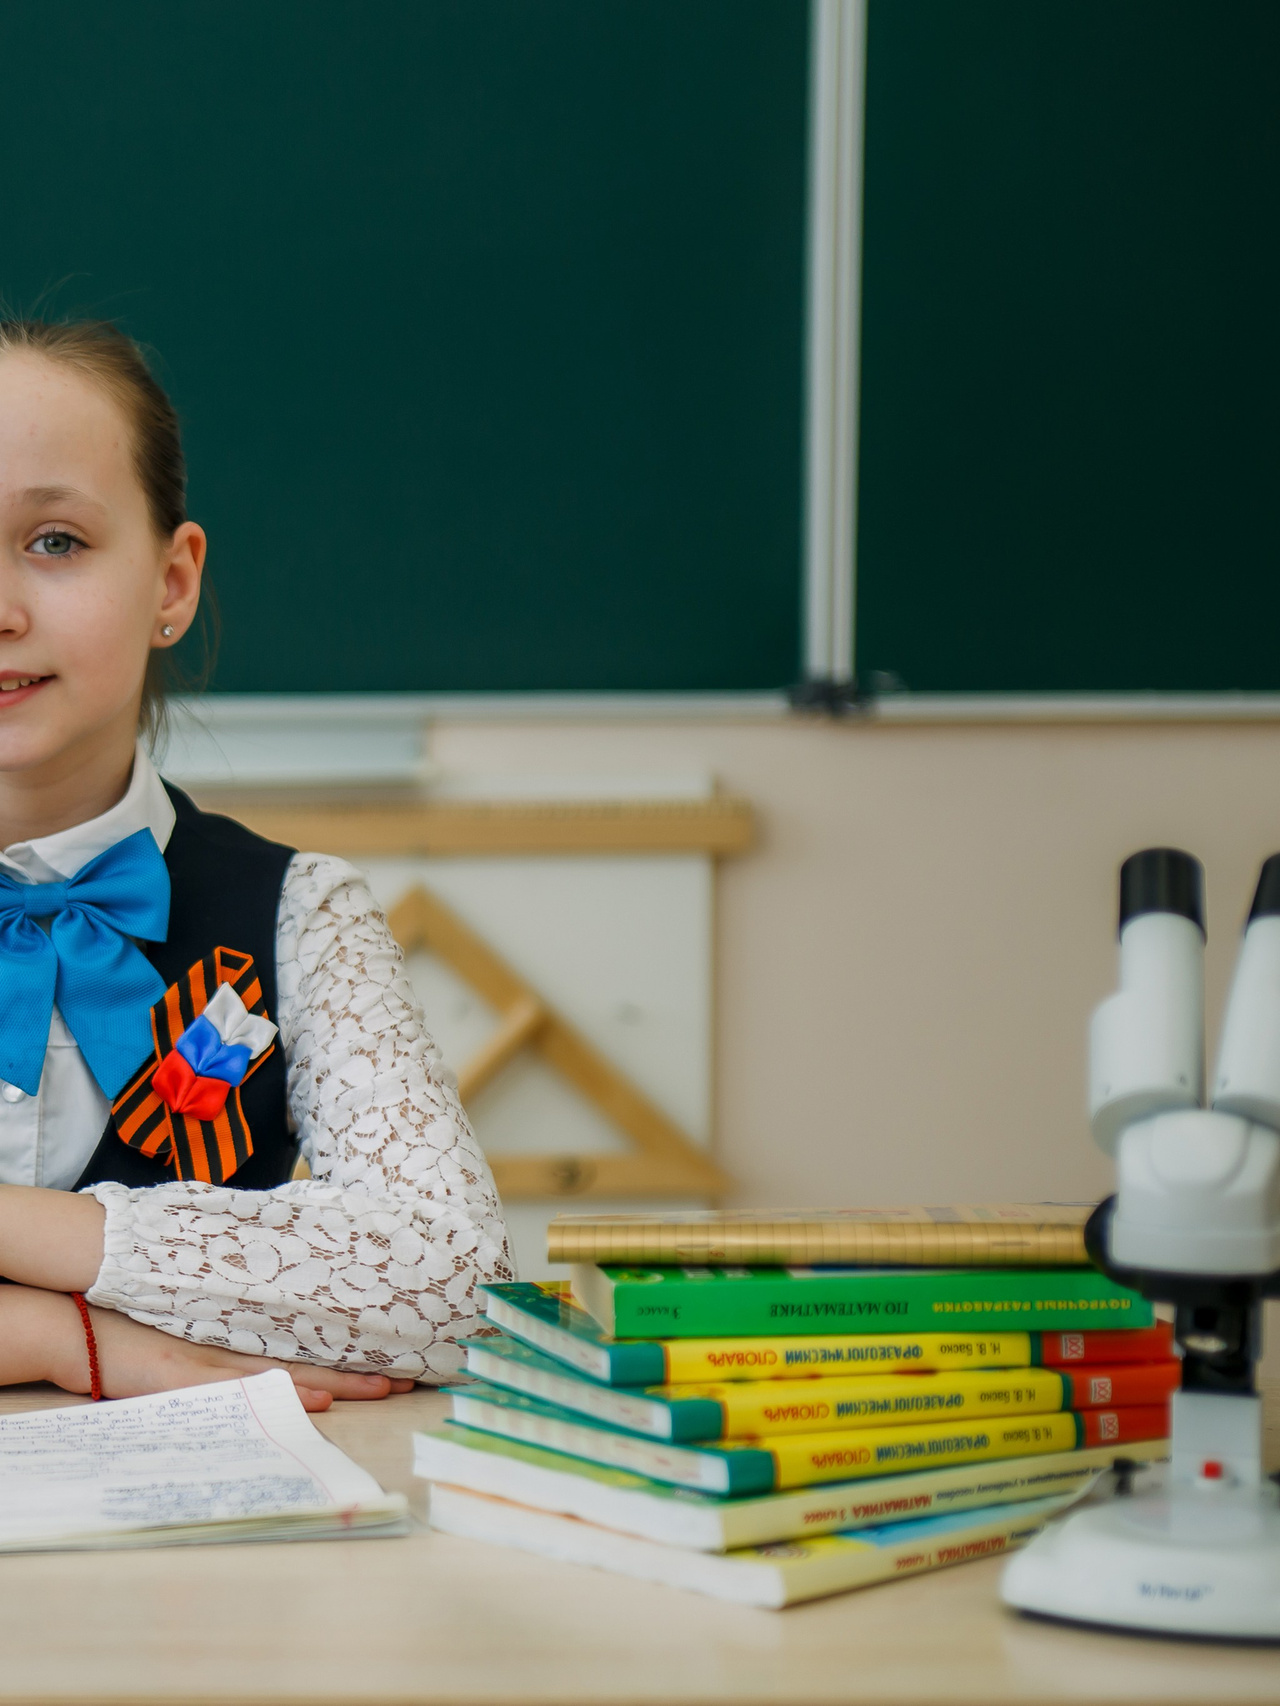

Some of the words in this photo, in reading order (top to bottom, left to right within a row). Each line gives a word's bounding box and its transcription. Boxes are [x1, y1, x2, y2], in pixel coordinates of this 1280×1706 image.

[770, 1302, 881, 1318] МАТЕМАТИКЕ
[885, 1302, 909, 1316] ПО
[932, 1300, 1032, 1313] РАЗРАБОТКИ
[1035, 1298, 1131, 1312] ПОУРОЧНЫЕ
[672, 1306, 682, 1319] 3
[785, 1344, 924, 1366] ФРАЗЕОЛОГИЧЕСКИЙ
[940, 1343, 973, 1357] Баско
[978, 1342, 988, 1355] В.
[990, 1342, 1001, 1355] Н.
[707, 1349, 778, 1367] СЛОВАРЬ
[980, 1389, 1010, 1403] Баско
[1014, 1389, 1023, 1402] В.
[1026, 1388, 1036, 1401] Н.
[764, 1402, 830, 1422] СЛОВАРЬ
[836, 1393, 964, 1417] ФРАЗЕОЛОГИЧЕСКИЙ
[1003, 1428, 1031, 1442] Баско
[1033, 1428, 1041, 1441] В.
[1043, 1427, 1053, 1439] Н.
[876, 1435, 990, 1462] ФРАЗЕОЛОГИЧЕСКИЙ
[812, 1446, 871, 1469] СЛОВАРЬ
[852, 1494, 932, 1520] МАТЕМАТИКА
[938, 1536, 1007, 1563] МАТЕМАТИКА
